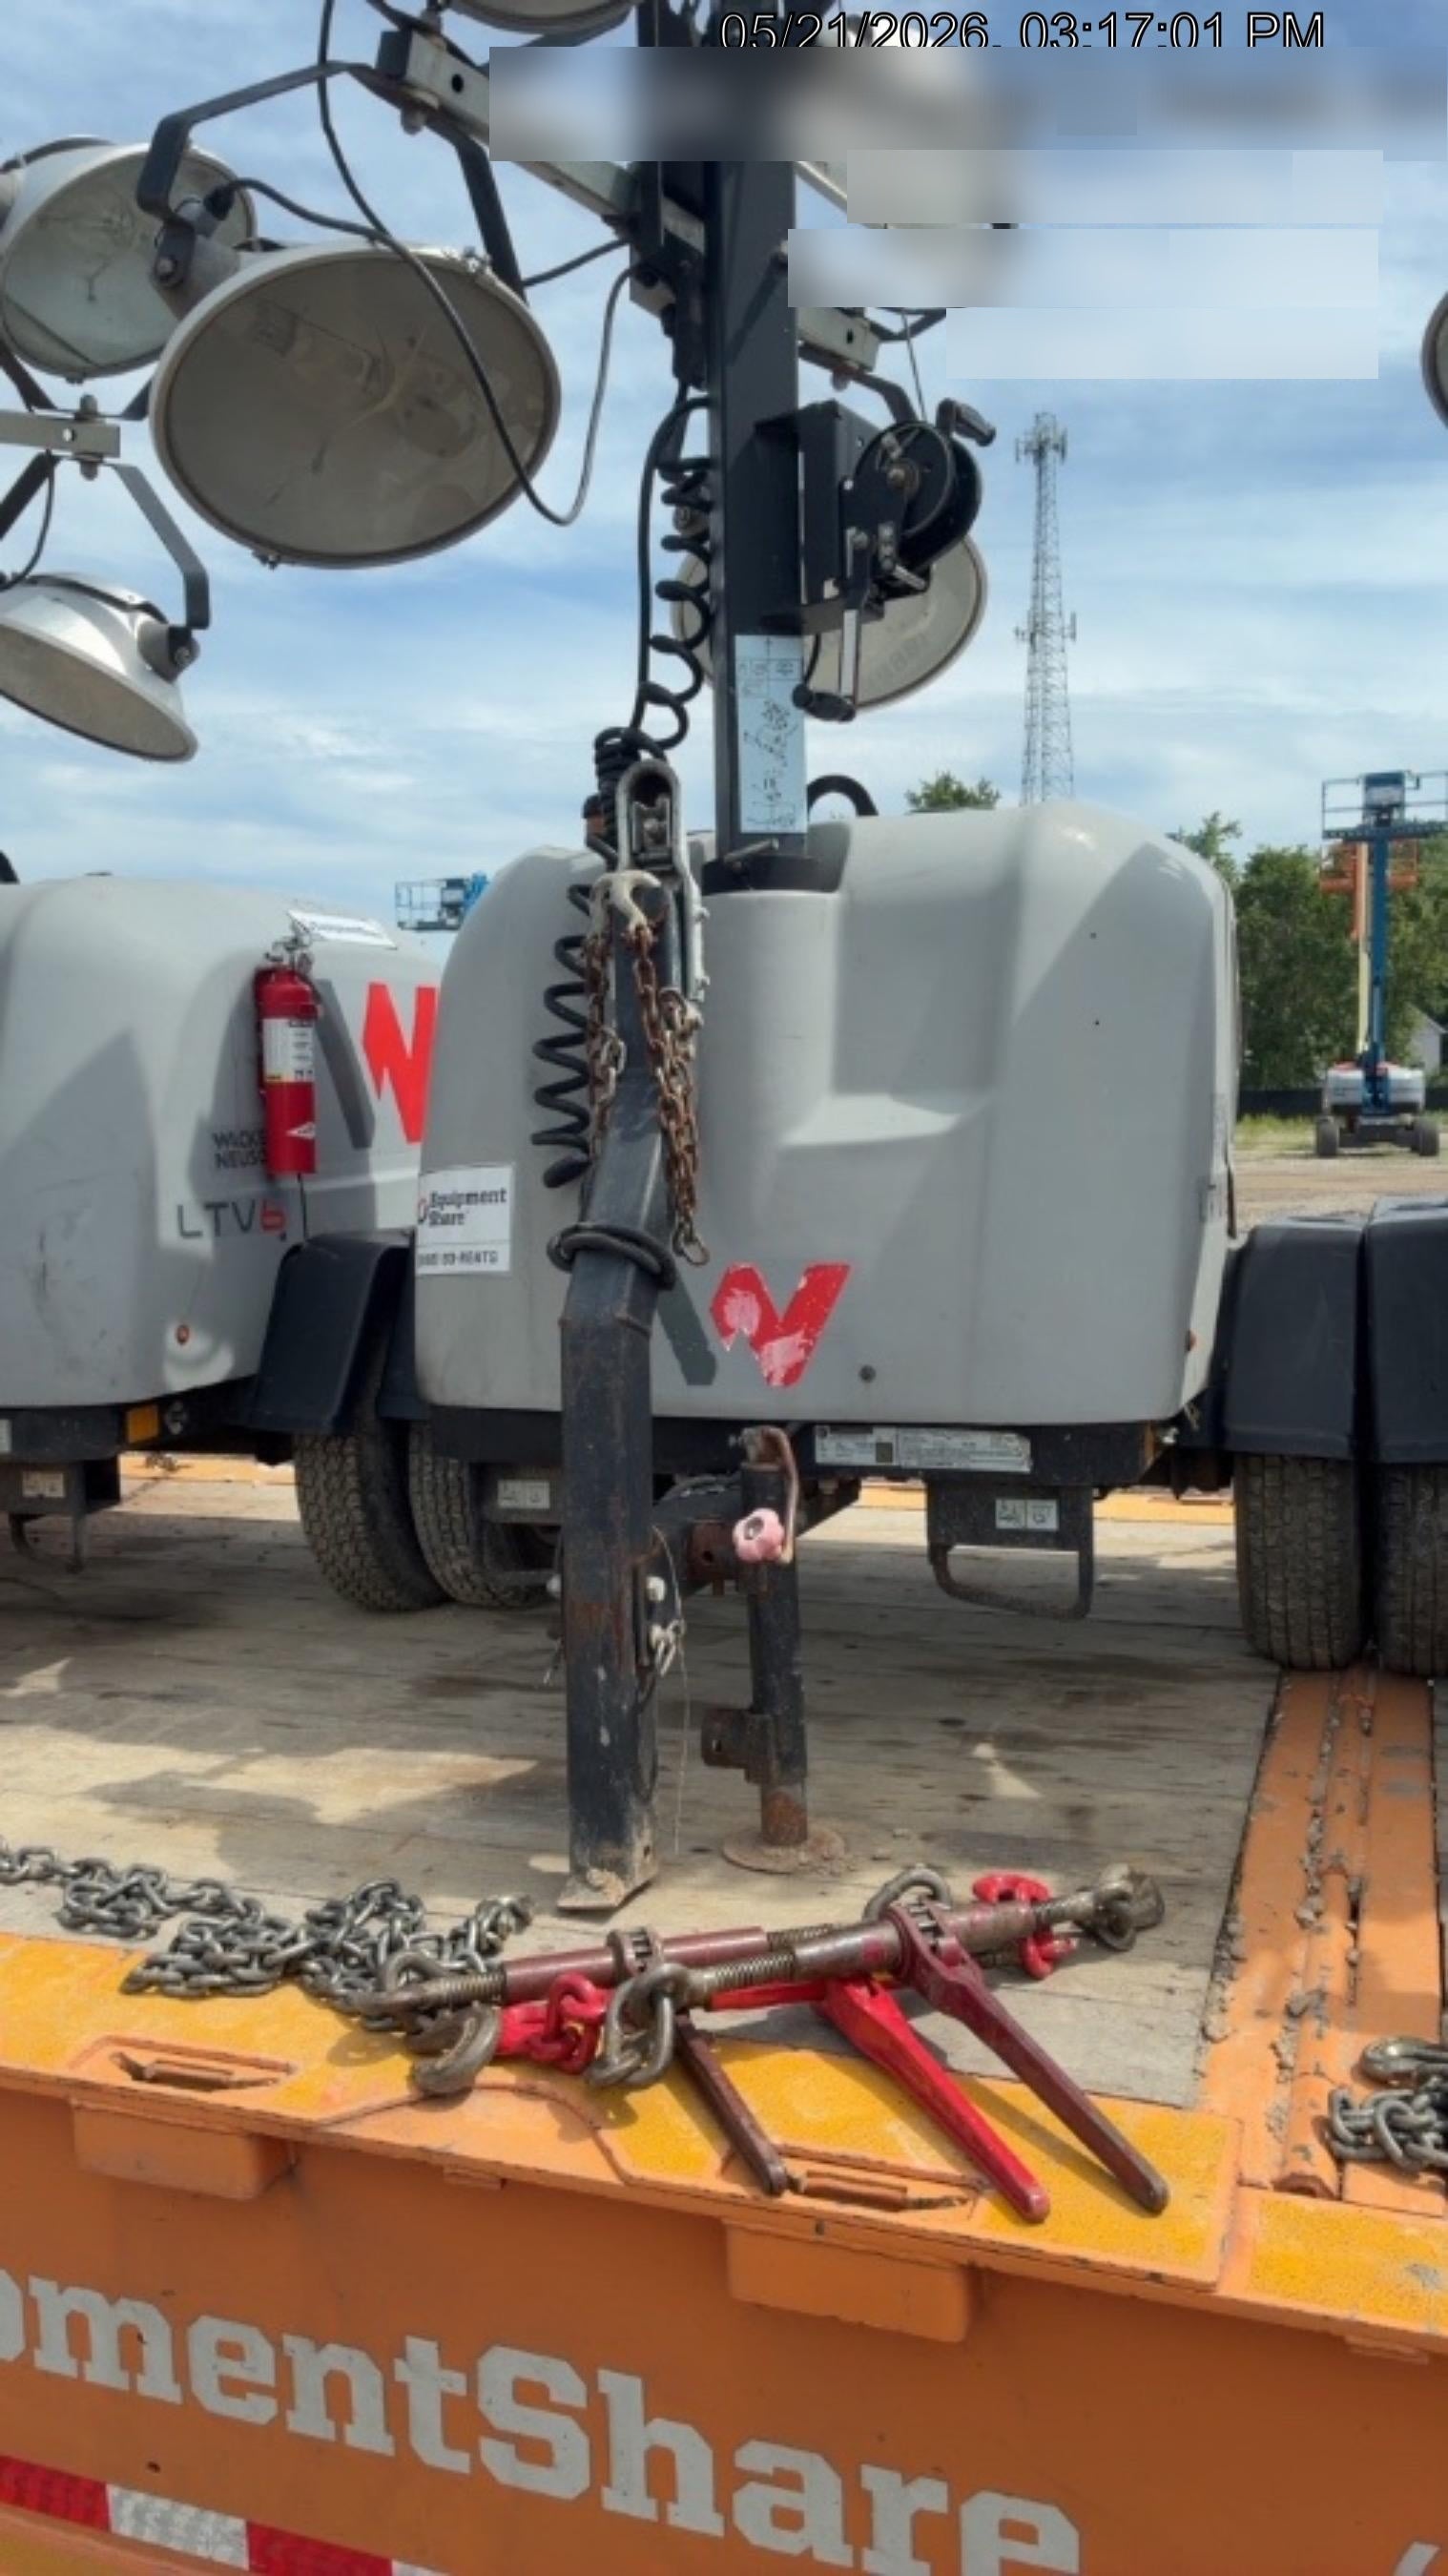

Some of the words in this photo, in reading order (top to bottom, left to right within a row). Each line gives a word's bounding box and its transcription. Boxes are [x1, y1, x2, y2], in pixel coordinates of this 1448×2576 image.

[429, 1188, 507, 1211] Equipment
[428, 1210, 465, 1228] Share
[0, 2269, 1080, 2576] mentShare
